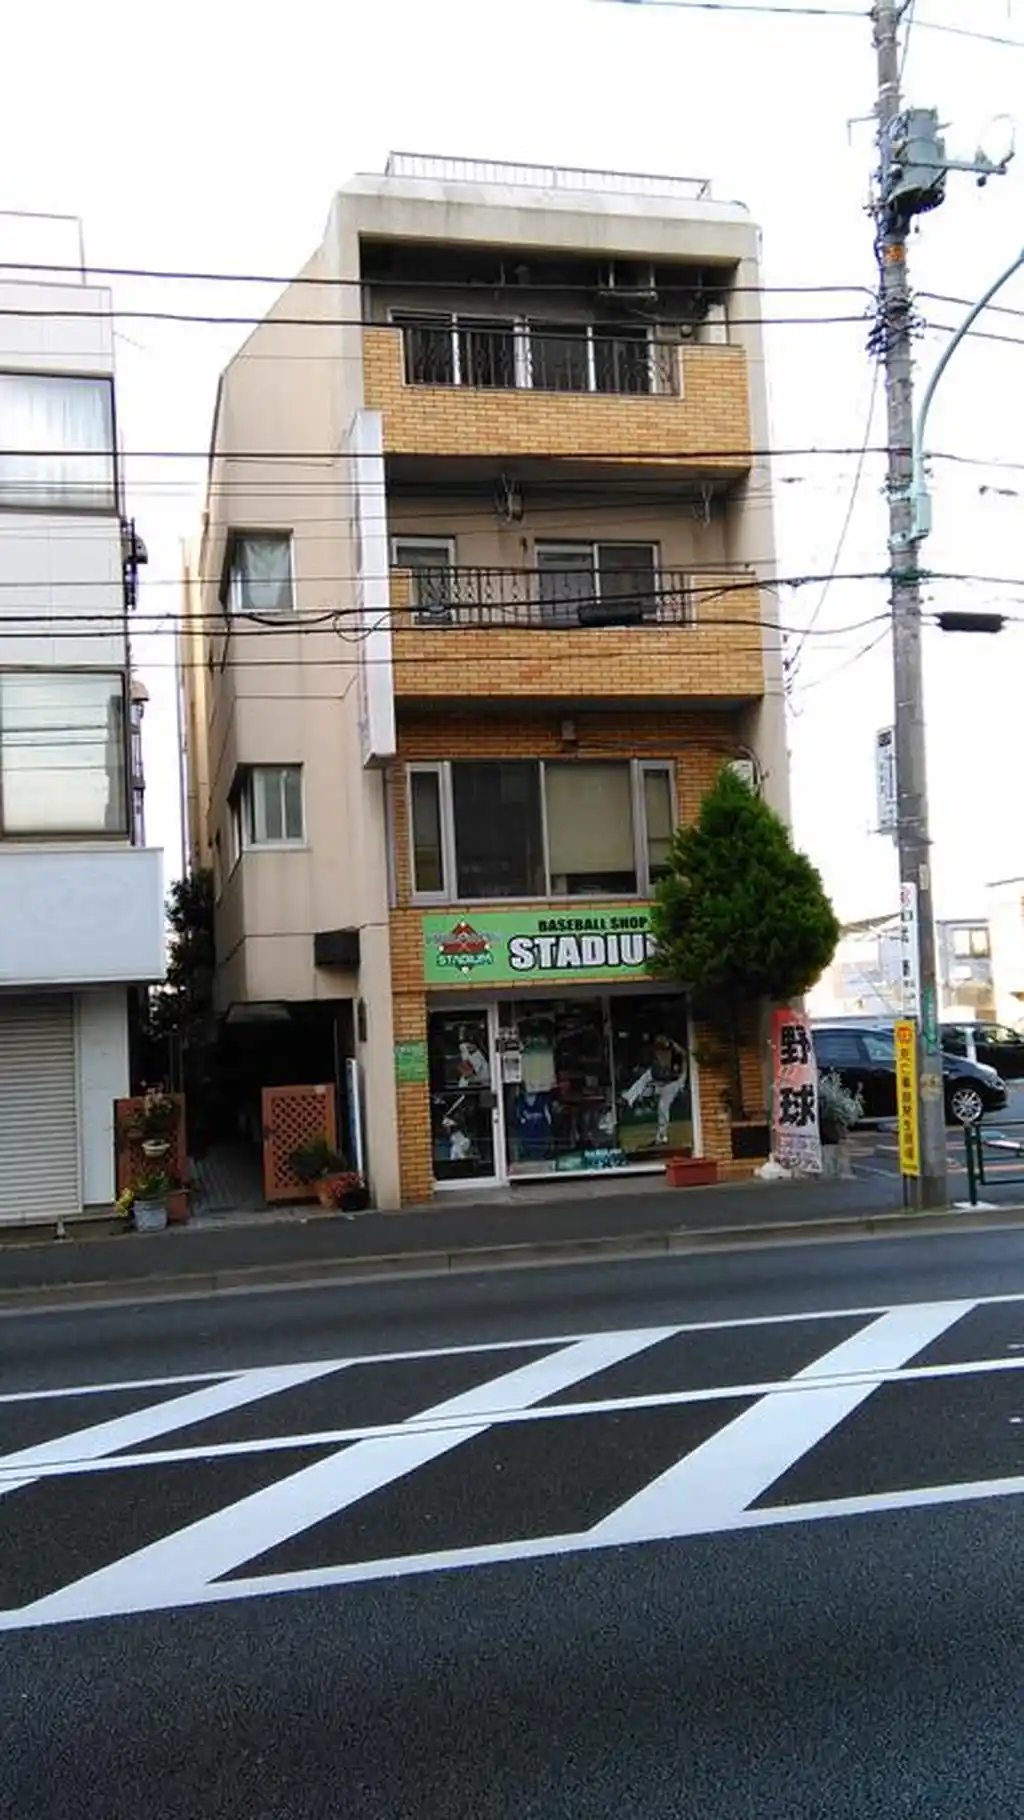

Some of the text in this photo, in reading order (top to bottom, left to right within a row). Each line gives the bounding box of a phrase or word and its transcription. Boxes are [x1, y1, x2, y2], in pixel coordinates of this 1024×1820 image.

[538, 916, 648, 932] BASEBALL SHOP
[779, 1024, 816, 1127] 野球
